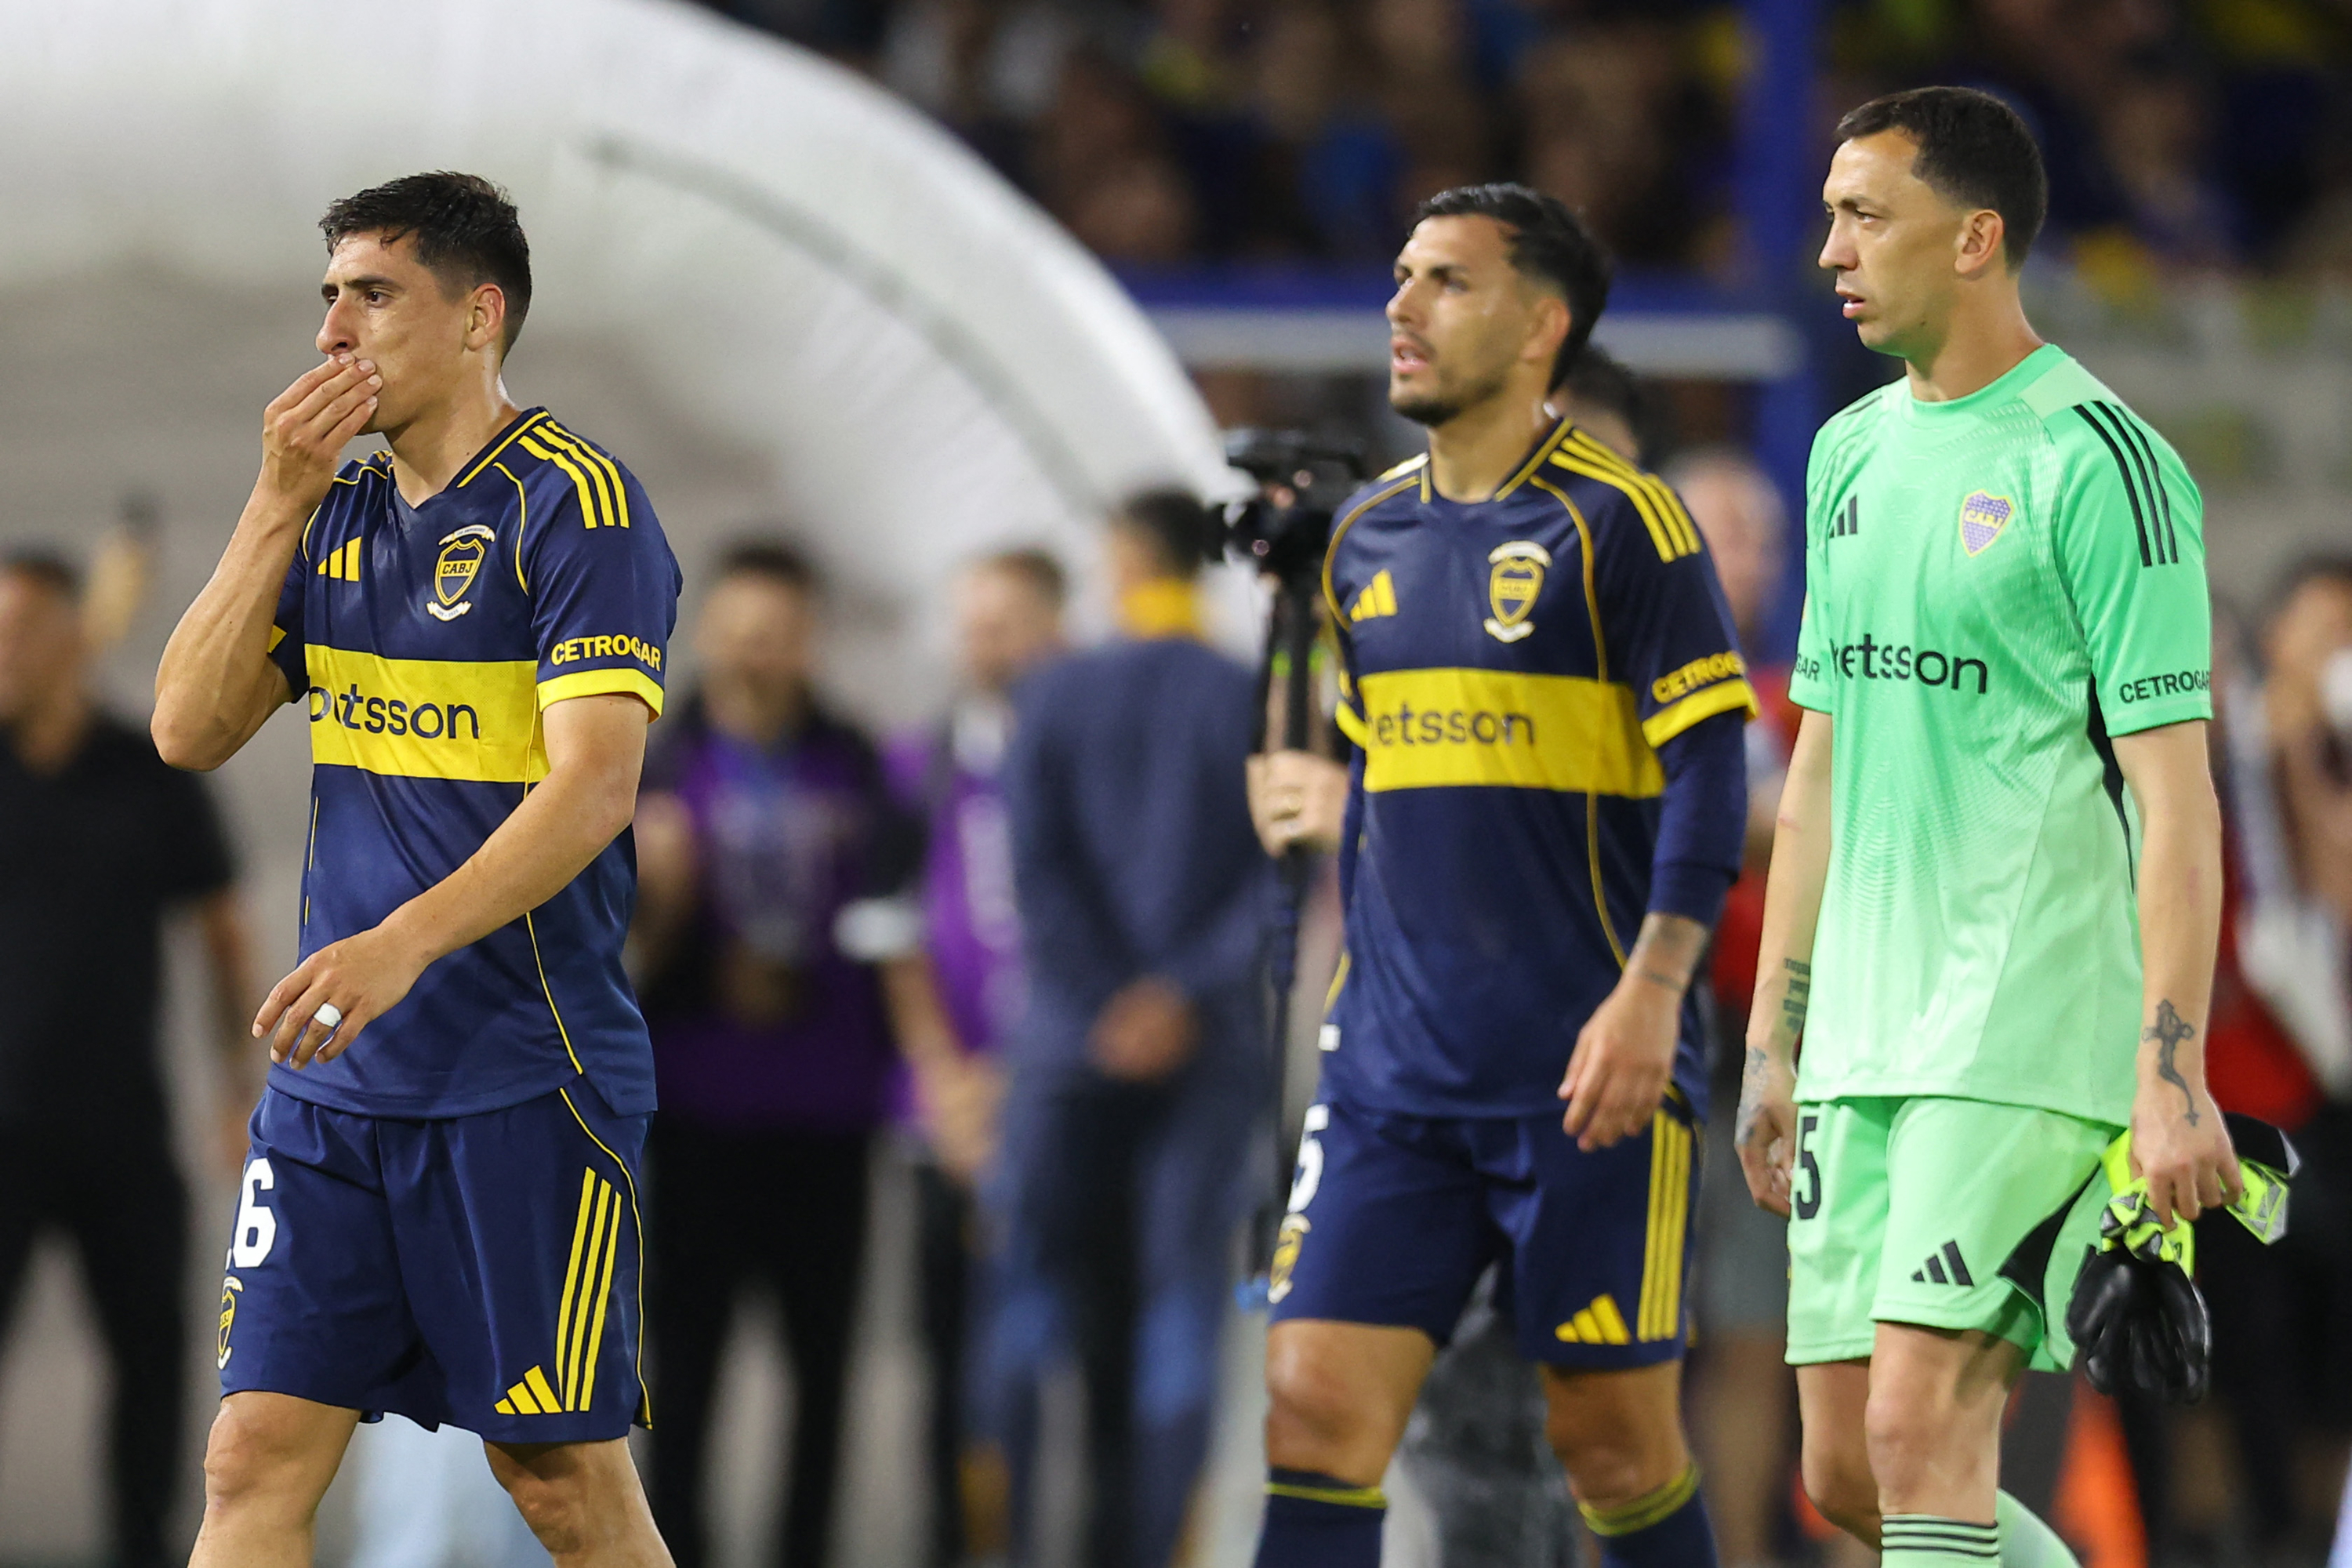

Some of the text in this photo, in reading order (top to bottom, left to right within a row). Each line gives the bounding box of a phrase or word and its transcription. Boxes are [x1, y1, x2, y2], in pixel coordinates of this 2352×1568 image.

[442, 563, 473, 574] CABJ
[551, 634, 661, 672] CETROGAR
[1366, 701, 1534, 746] etsson
[1795, 1116, 1821, 1220] 5
